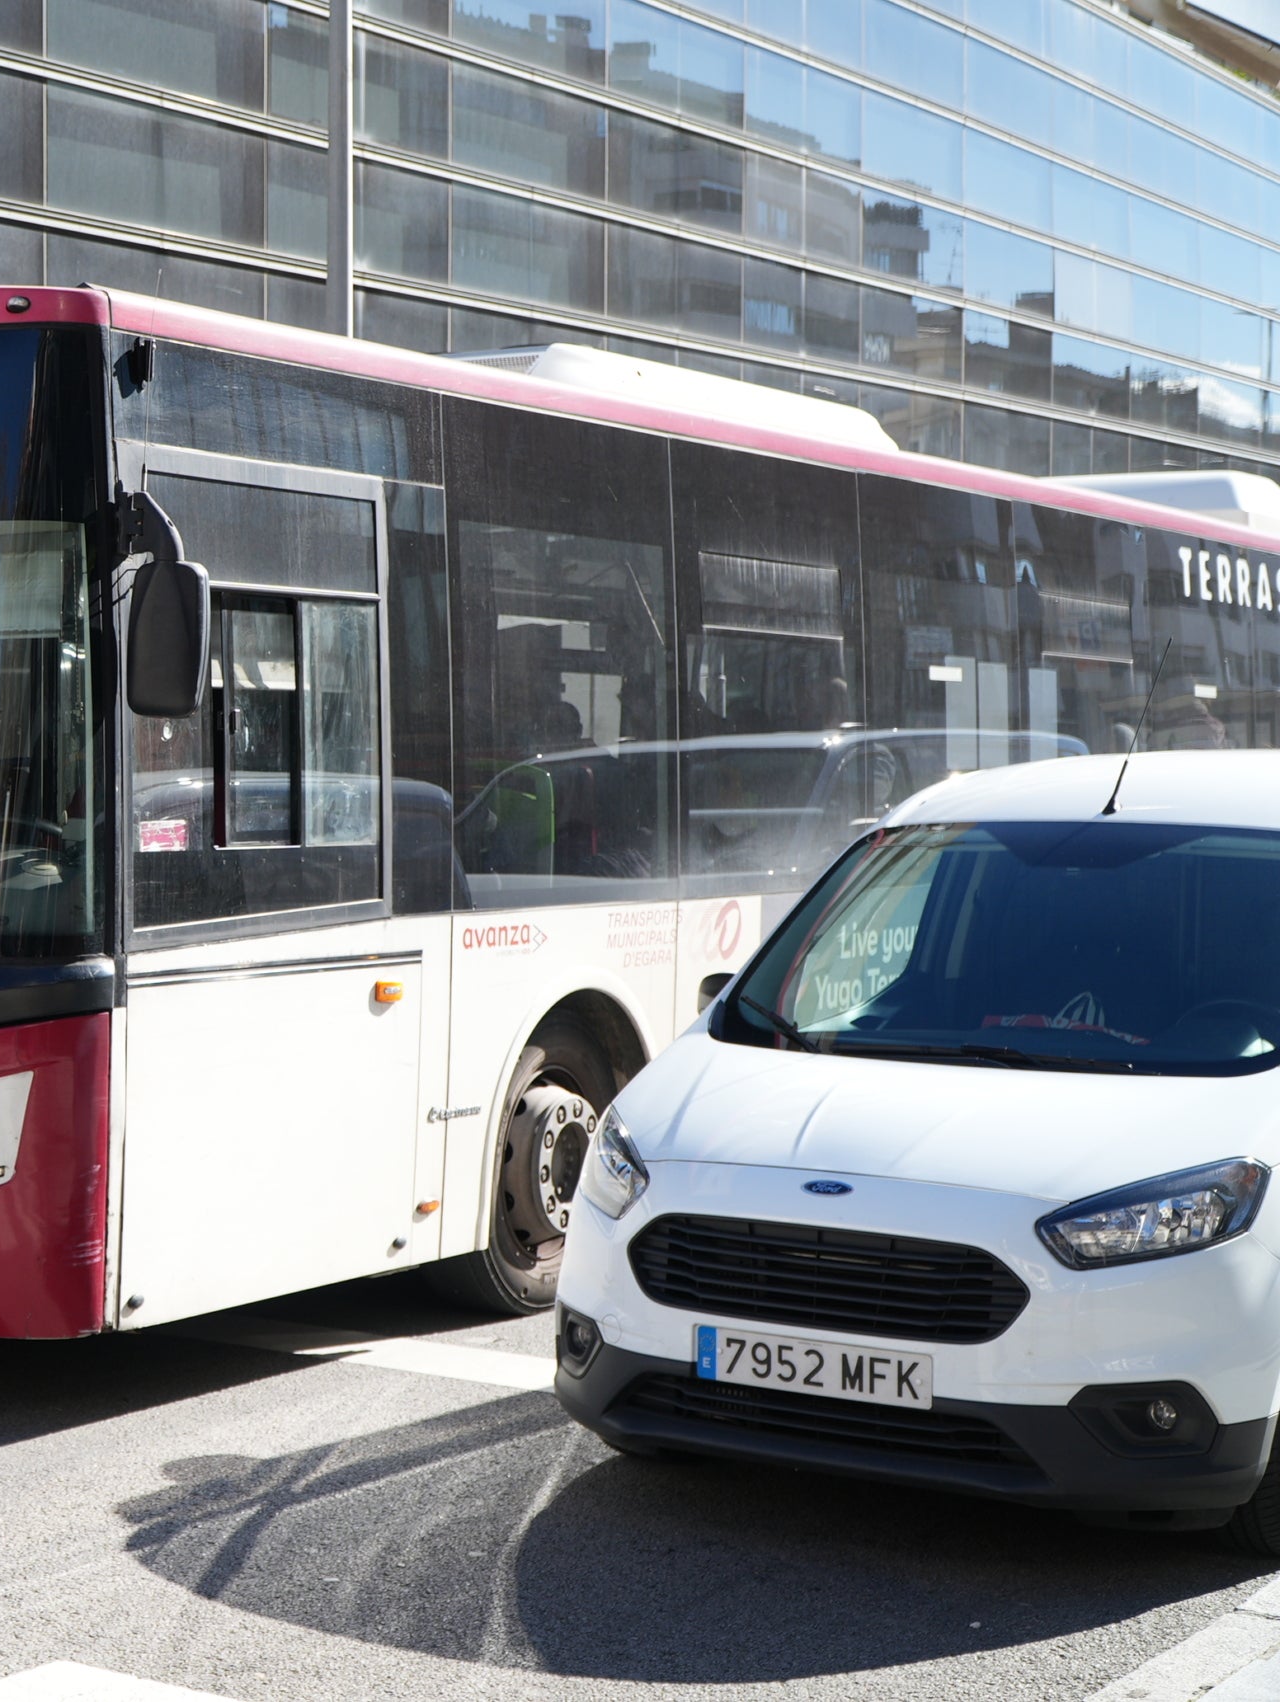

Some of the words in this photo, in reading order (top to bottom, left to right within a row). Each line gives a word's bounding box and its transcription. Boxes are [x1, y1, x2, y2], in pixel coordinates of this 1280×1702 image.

[1178, 546, 1280, 613] TERRA
[608, 908, 684, 929] TRANSPORTS
[463, 923, 531, 950] avanza
[607, 929, 679, 950] MUNICIPALS
[839, 922, 879, 960] Live
[882, 924, 918, 964] you
[623, 950, 673, 969] D'EGARA
[815, 975, 863, 1013] Yugo
[702, 1357, 711, 1368] E
[726, 1337, 825, 1388] 7952
[841, 1353, 920, 1400] MFK
